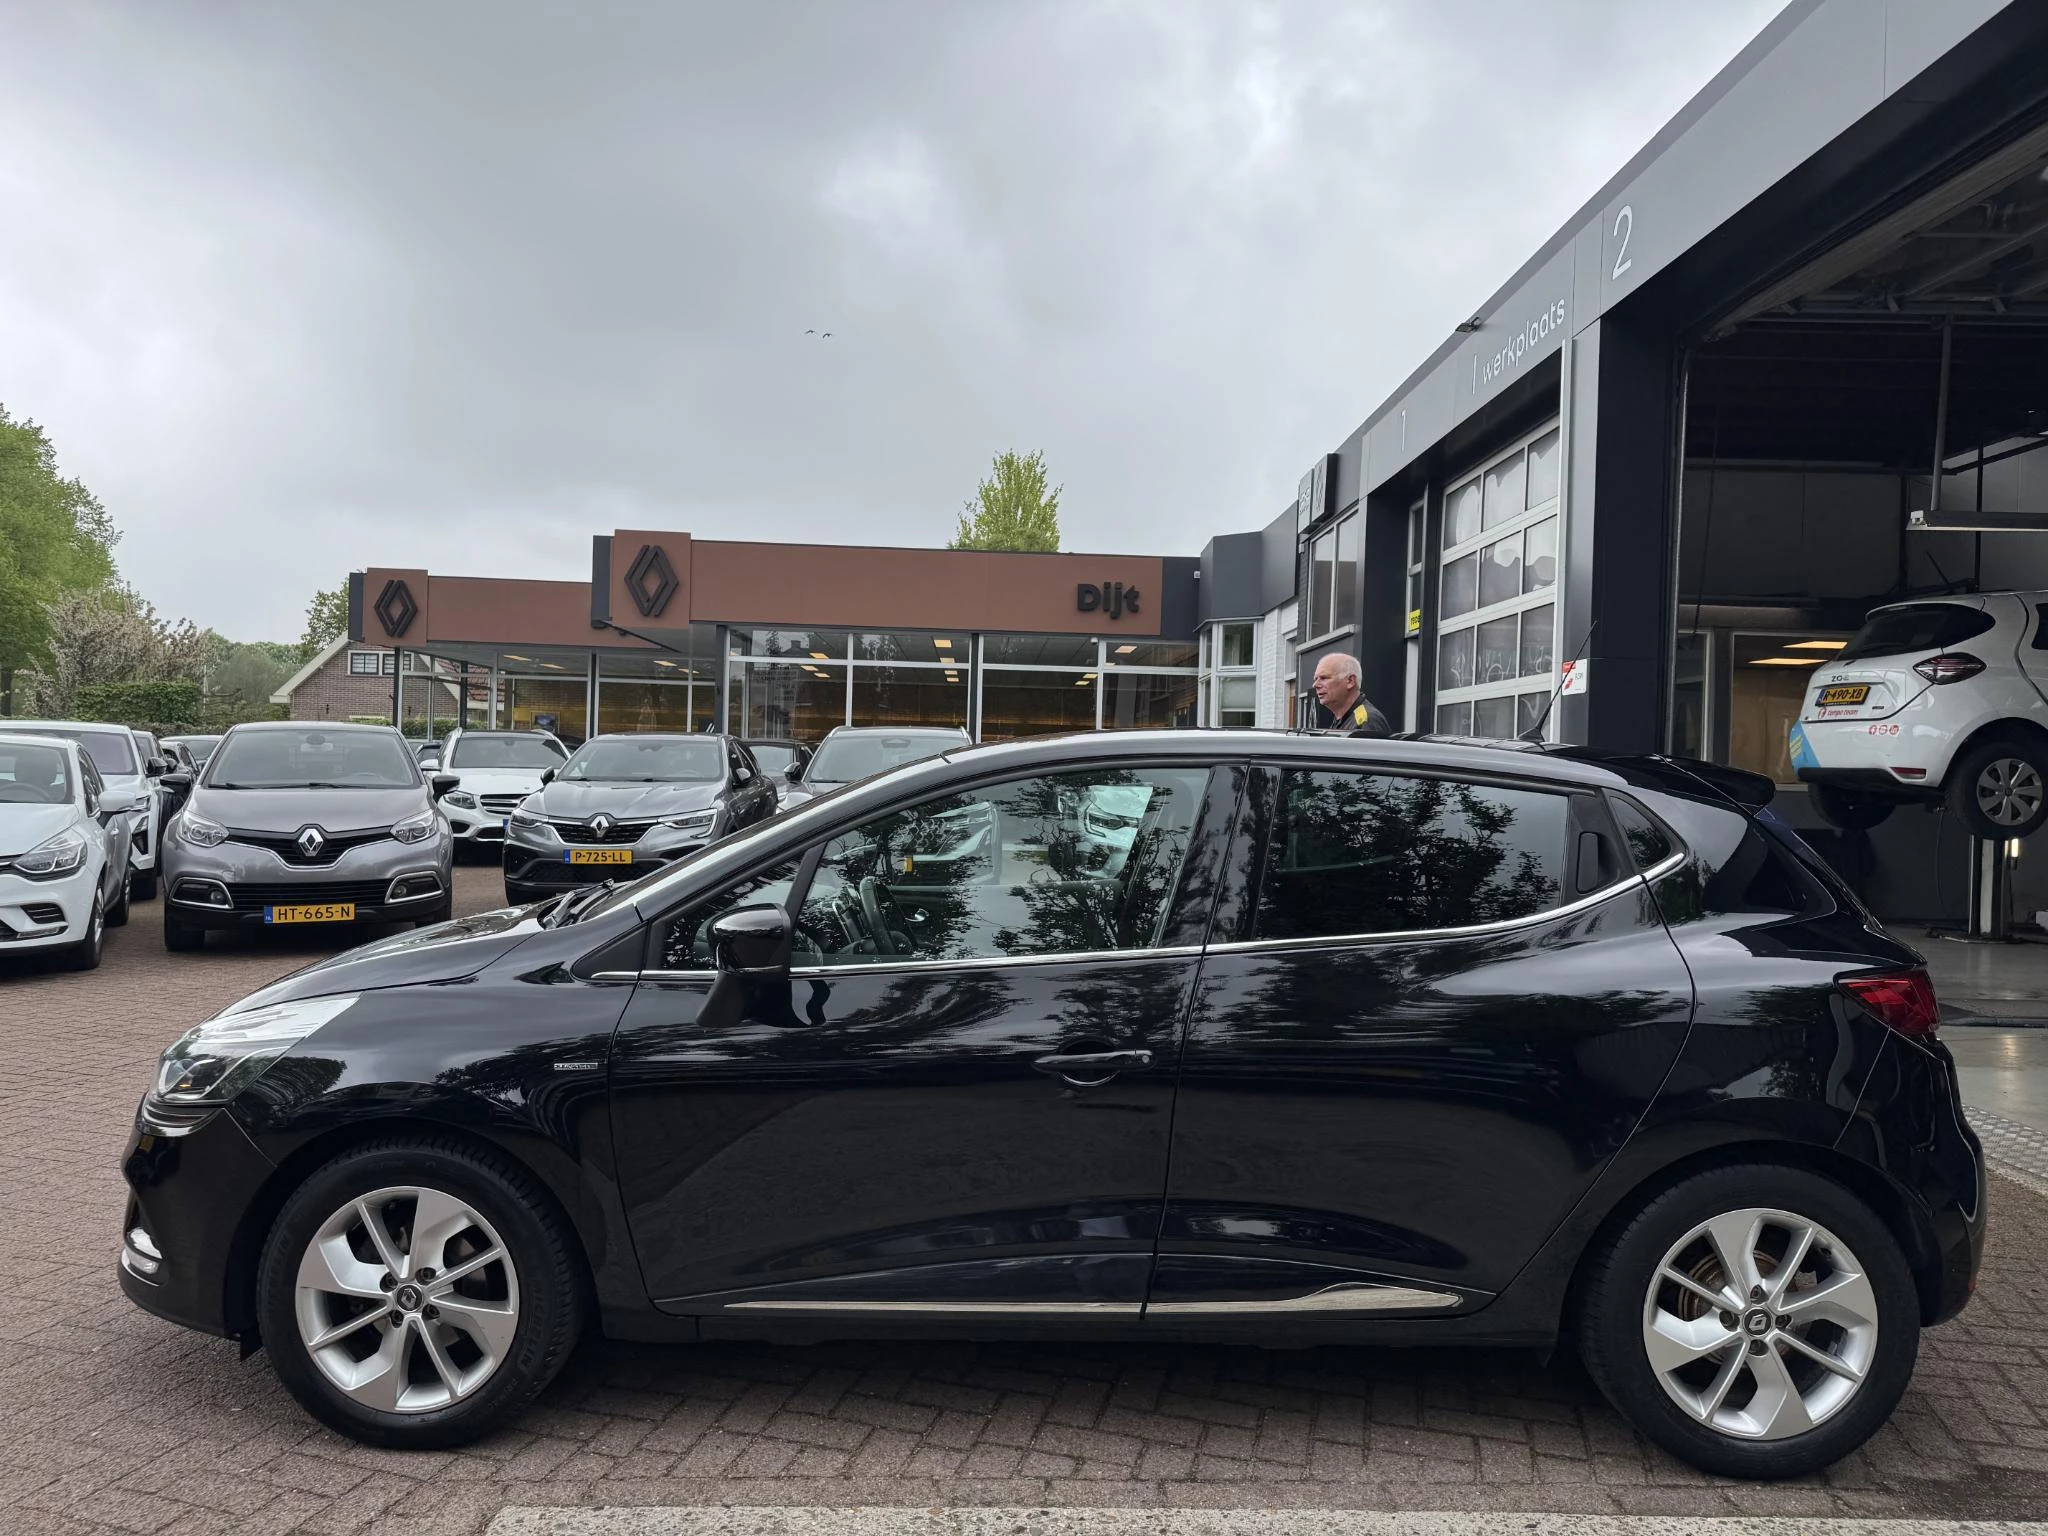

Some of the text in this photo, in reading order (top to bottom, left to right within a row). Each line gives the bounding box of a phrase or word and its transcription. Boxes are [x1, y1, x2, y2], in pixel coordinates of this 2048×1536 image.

[1612, 205, 1633, 280] 2
[1482, 298, 1565, 385] werkplaats
[1401, 408, 1407, 452] 1
[575, 851, 626, 862] P-725-LL
[278, 905, 350, 920] HT-665-N
